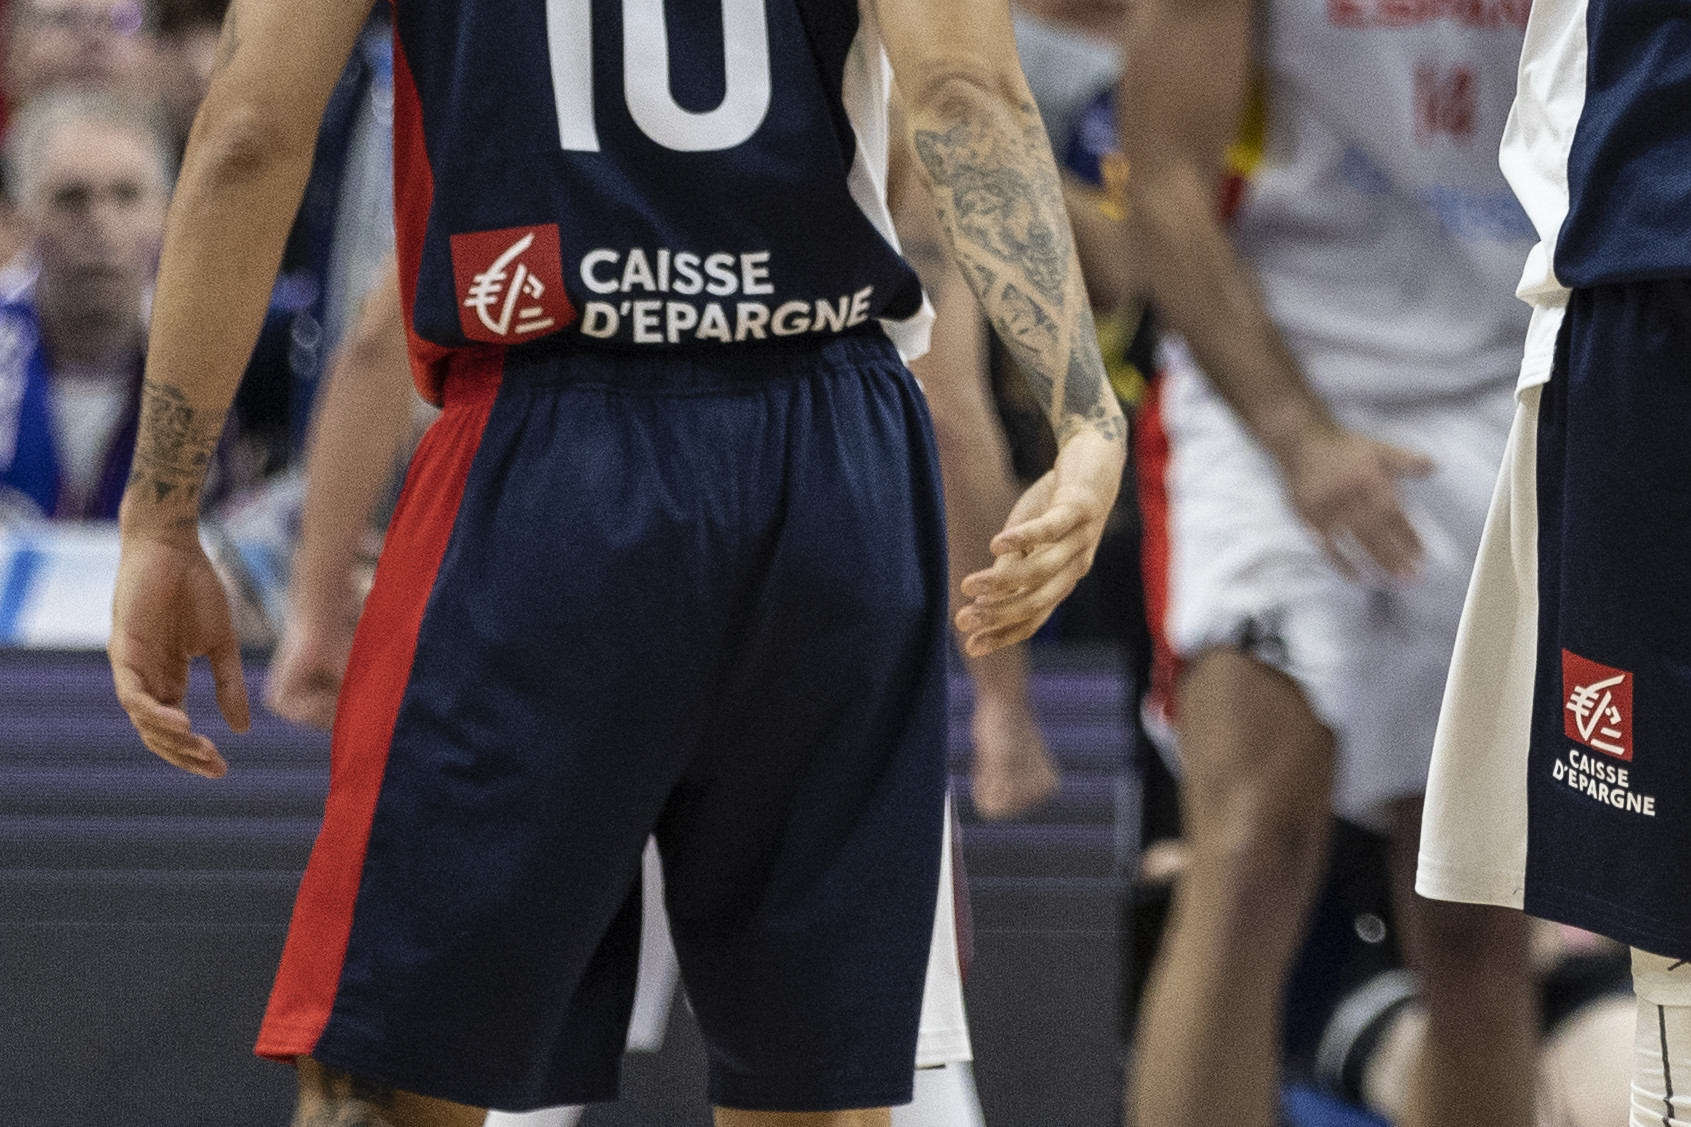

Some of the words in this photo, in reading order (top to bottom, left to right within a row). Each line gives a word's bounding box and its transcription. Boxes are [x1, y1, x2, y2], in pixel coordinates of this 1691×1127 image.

[579, 248, 775, 297] CAISSE
[579, 284, 875, 344] D'EPARGNE
[1552, 758, 1656, 817] D'EPARGNE
[1569, 748, 1630, 789] CAISSE
